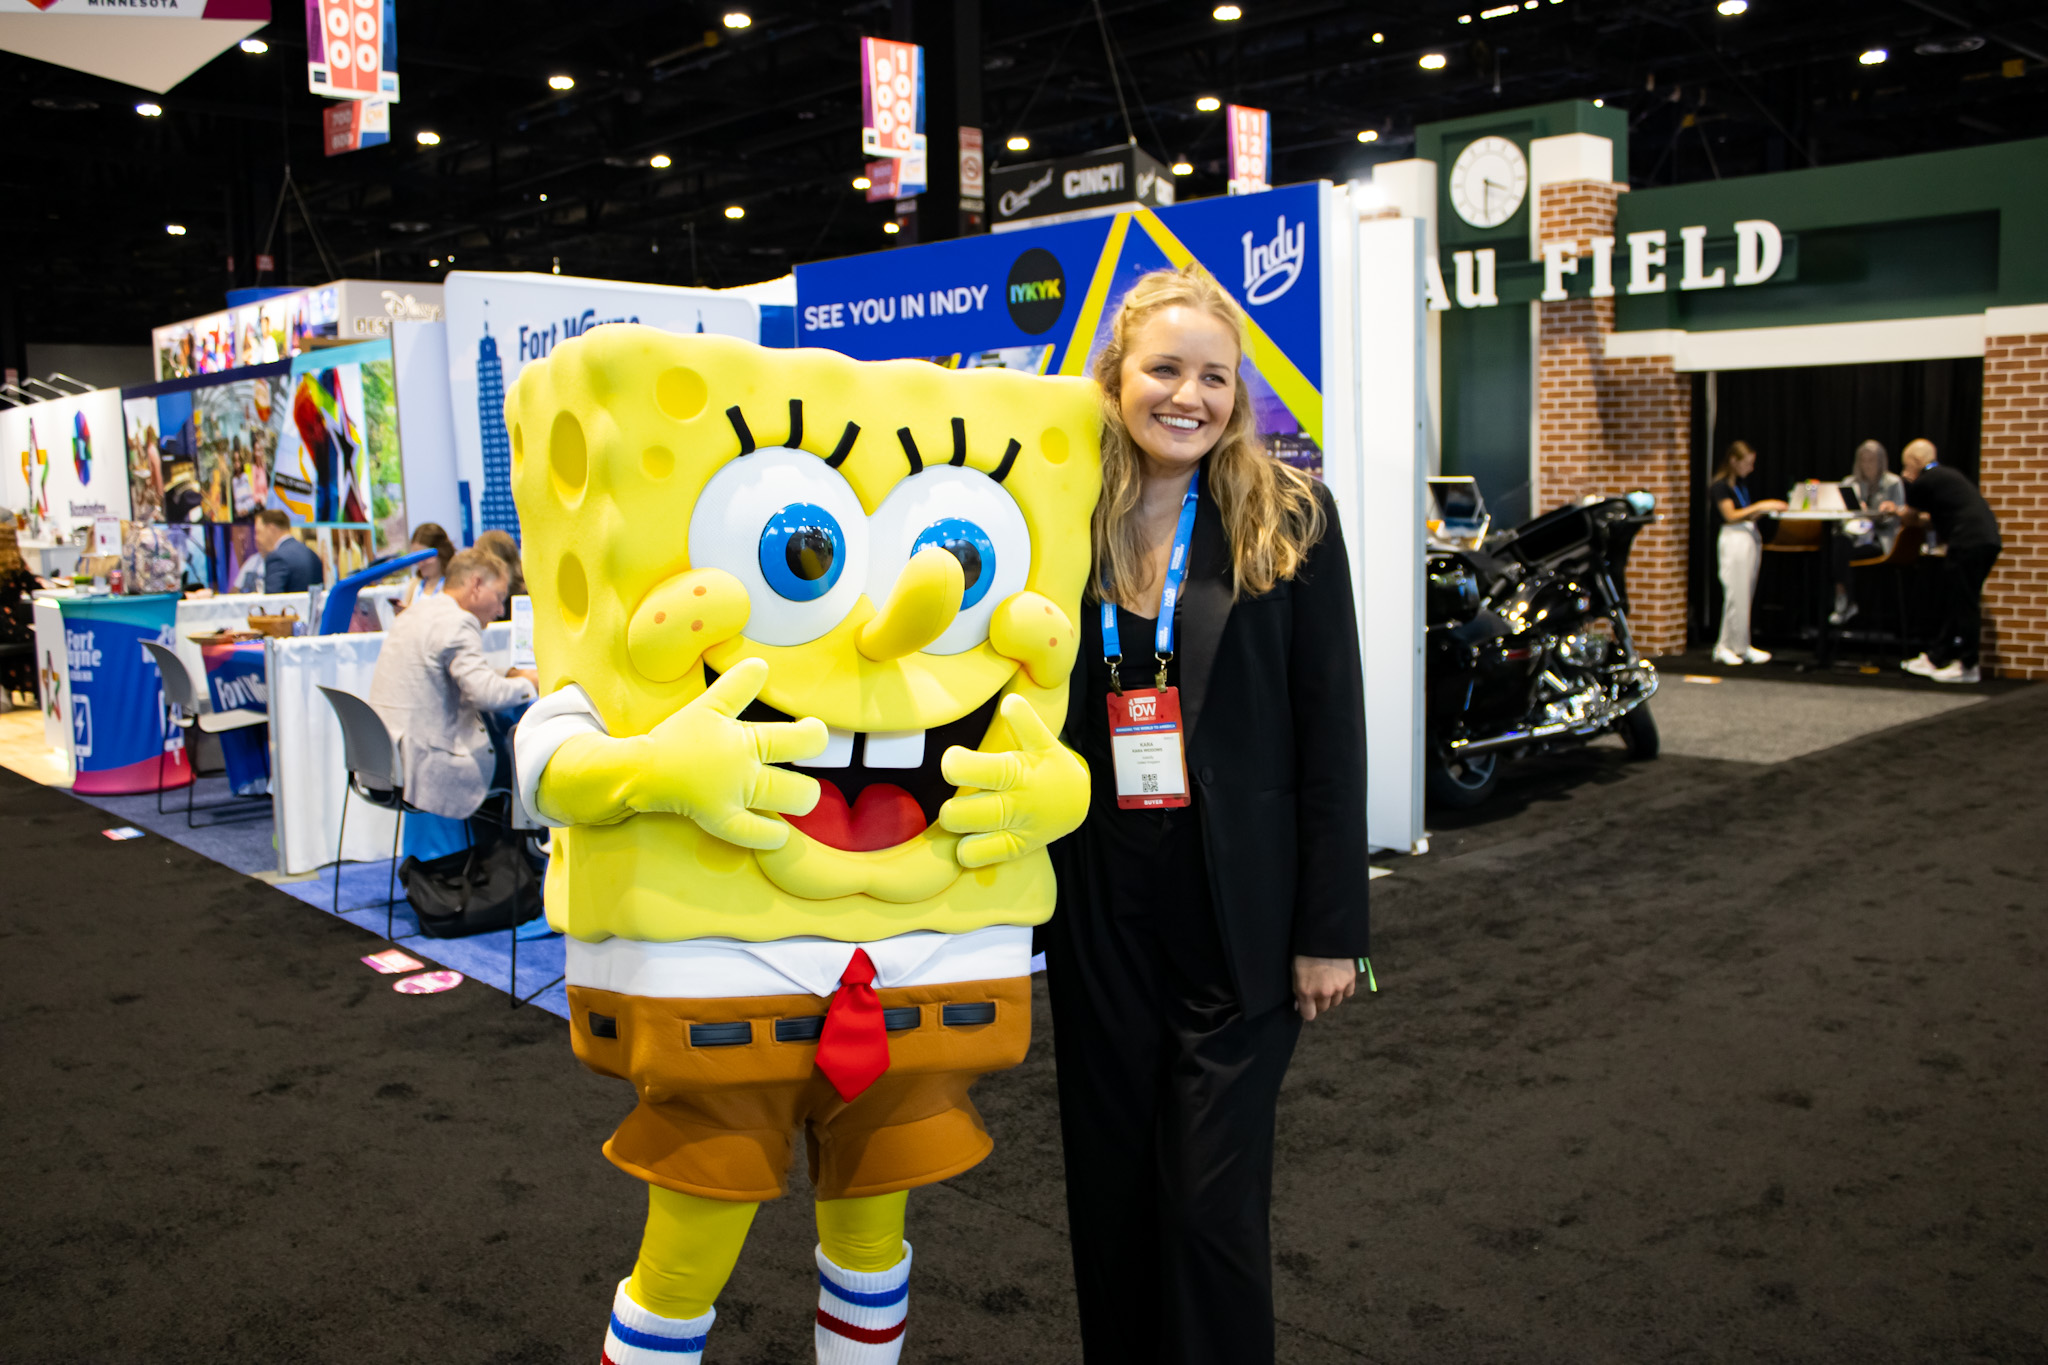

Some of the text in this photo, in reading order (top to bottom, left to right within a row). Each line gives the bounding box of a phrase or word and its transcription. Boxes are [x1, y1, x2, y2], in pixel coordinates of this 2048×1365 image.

[1010, 278, 1062, 304] IYKYK
[1241, 214, 1305, 306] Indy
[1541, 219, 1783, 302] FIELD
[804, 284, 989, 331] SEE YOU IN INDY
